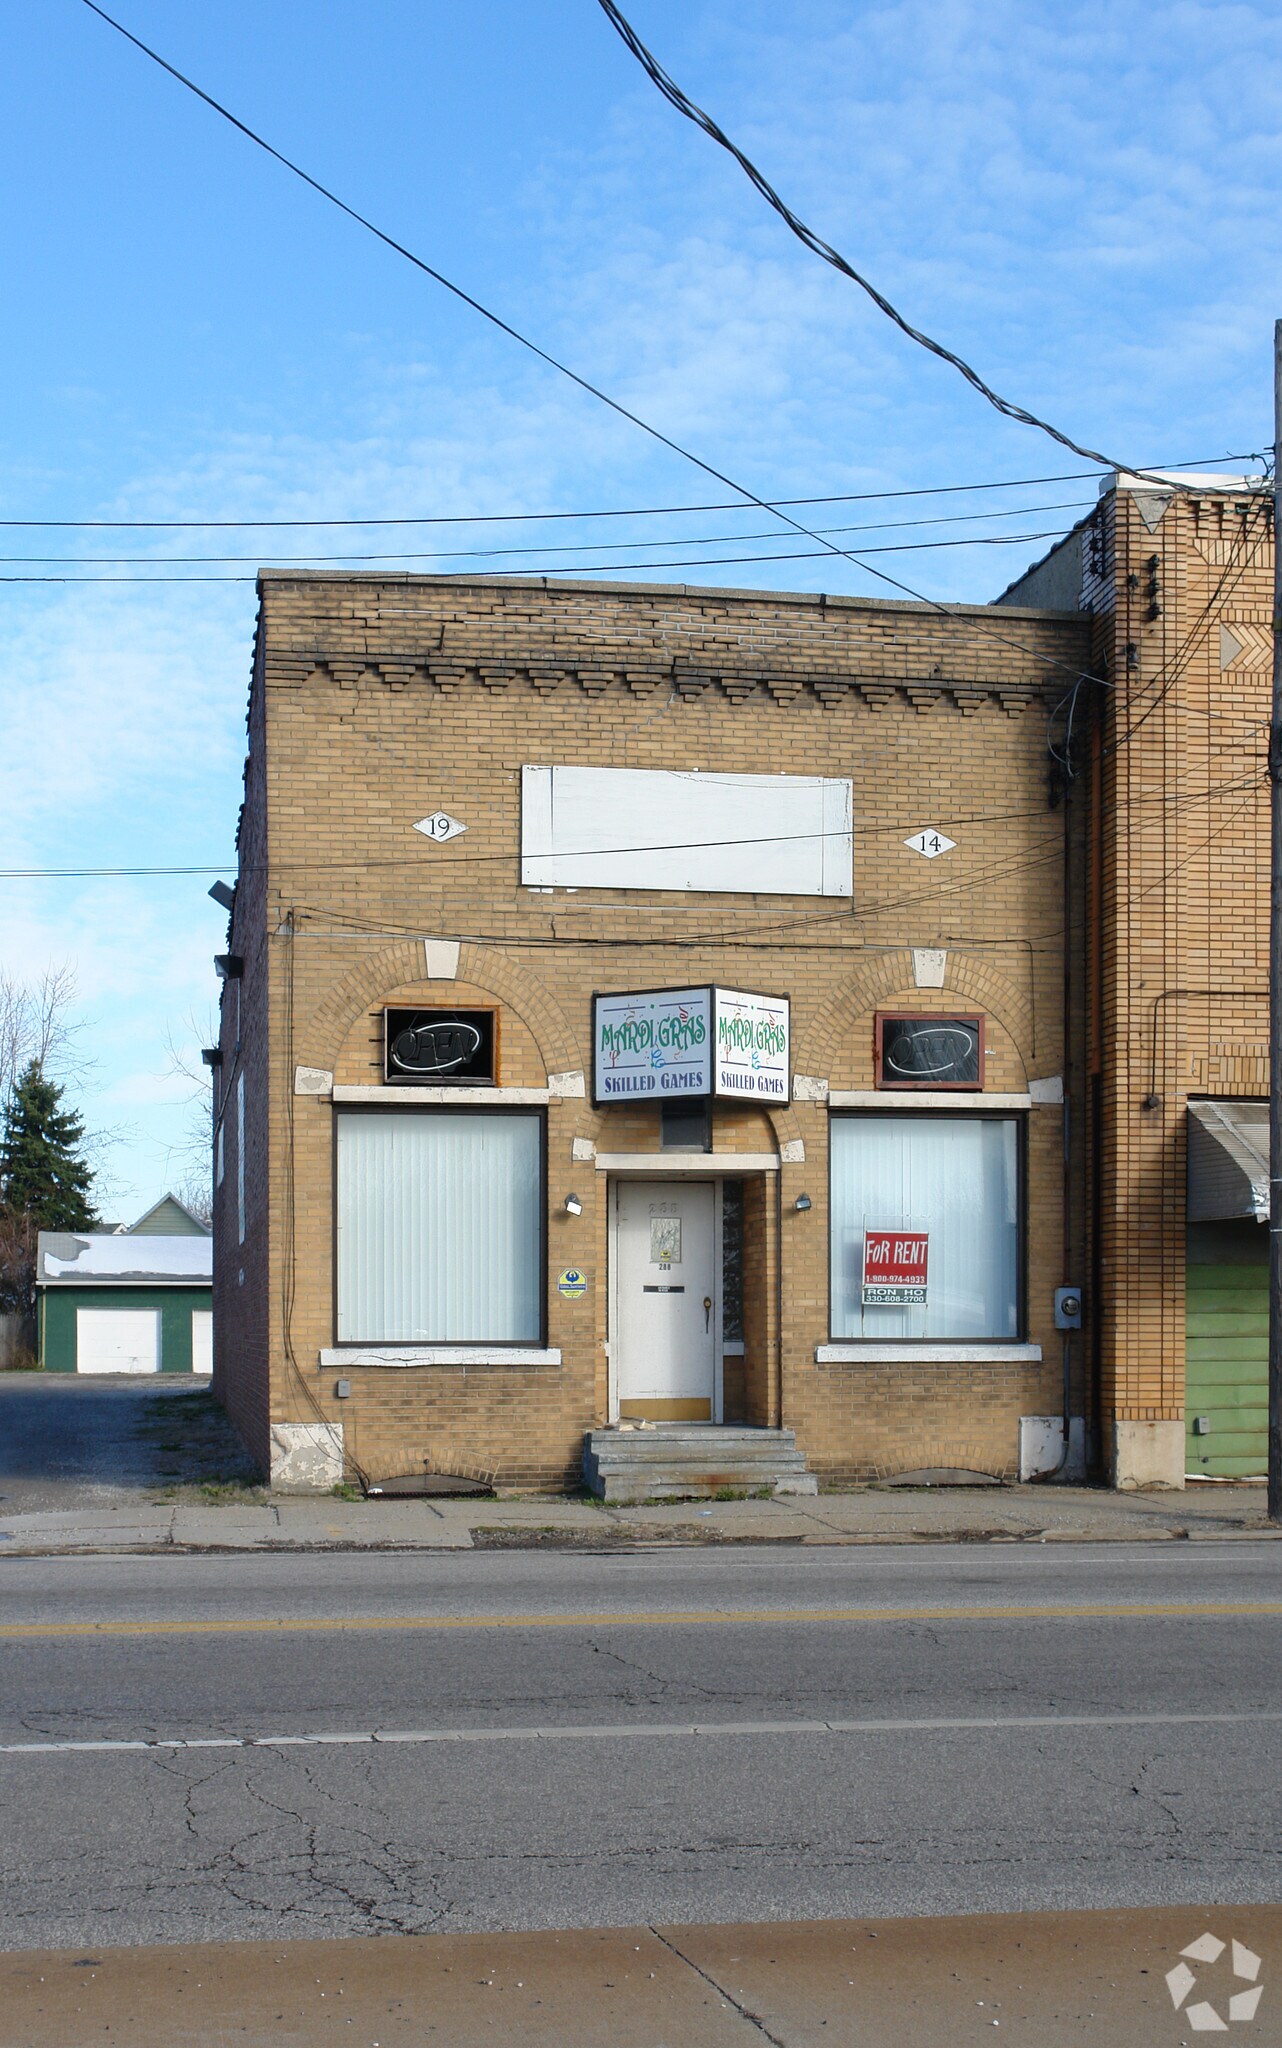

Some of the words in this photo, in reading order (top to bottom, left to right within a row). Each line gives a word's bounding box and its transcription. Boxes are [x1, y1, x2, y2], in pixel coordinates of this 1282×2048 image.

[428, 818, 450, 838] 19
[920, 835, 942, 852] 14
[601, 1019, 655, 1055] MARDI
[658, 1014, 706, 1052] GRAS
[718, 1016, 755, 1052] MARDI
[756, 1019, 786, 1057] GRAS
[604, 1075, 656, 1094] SKILLED
[660, 1071, 703, 1090] GAMES
[720, 1071, 755, 1091] SKILLED
[757, 1075, 784, 1094] GAMES
[893, 1241, 928, 1264] RENT
